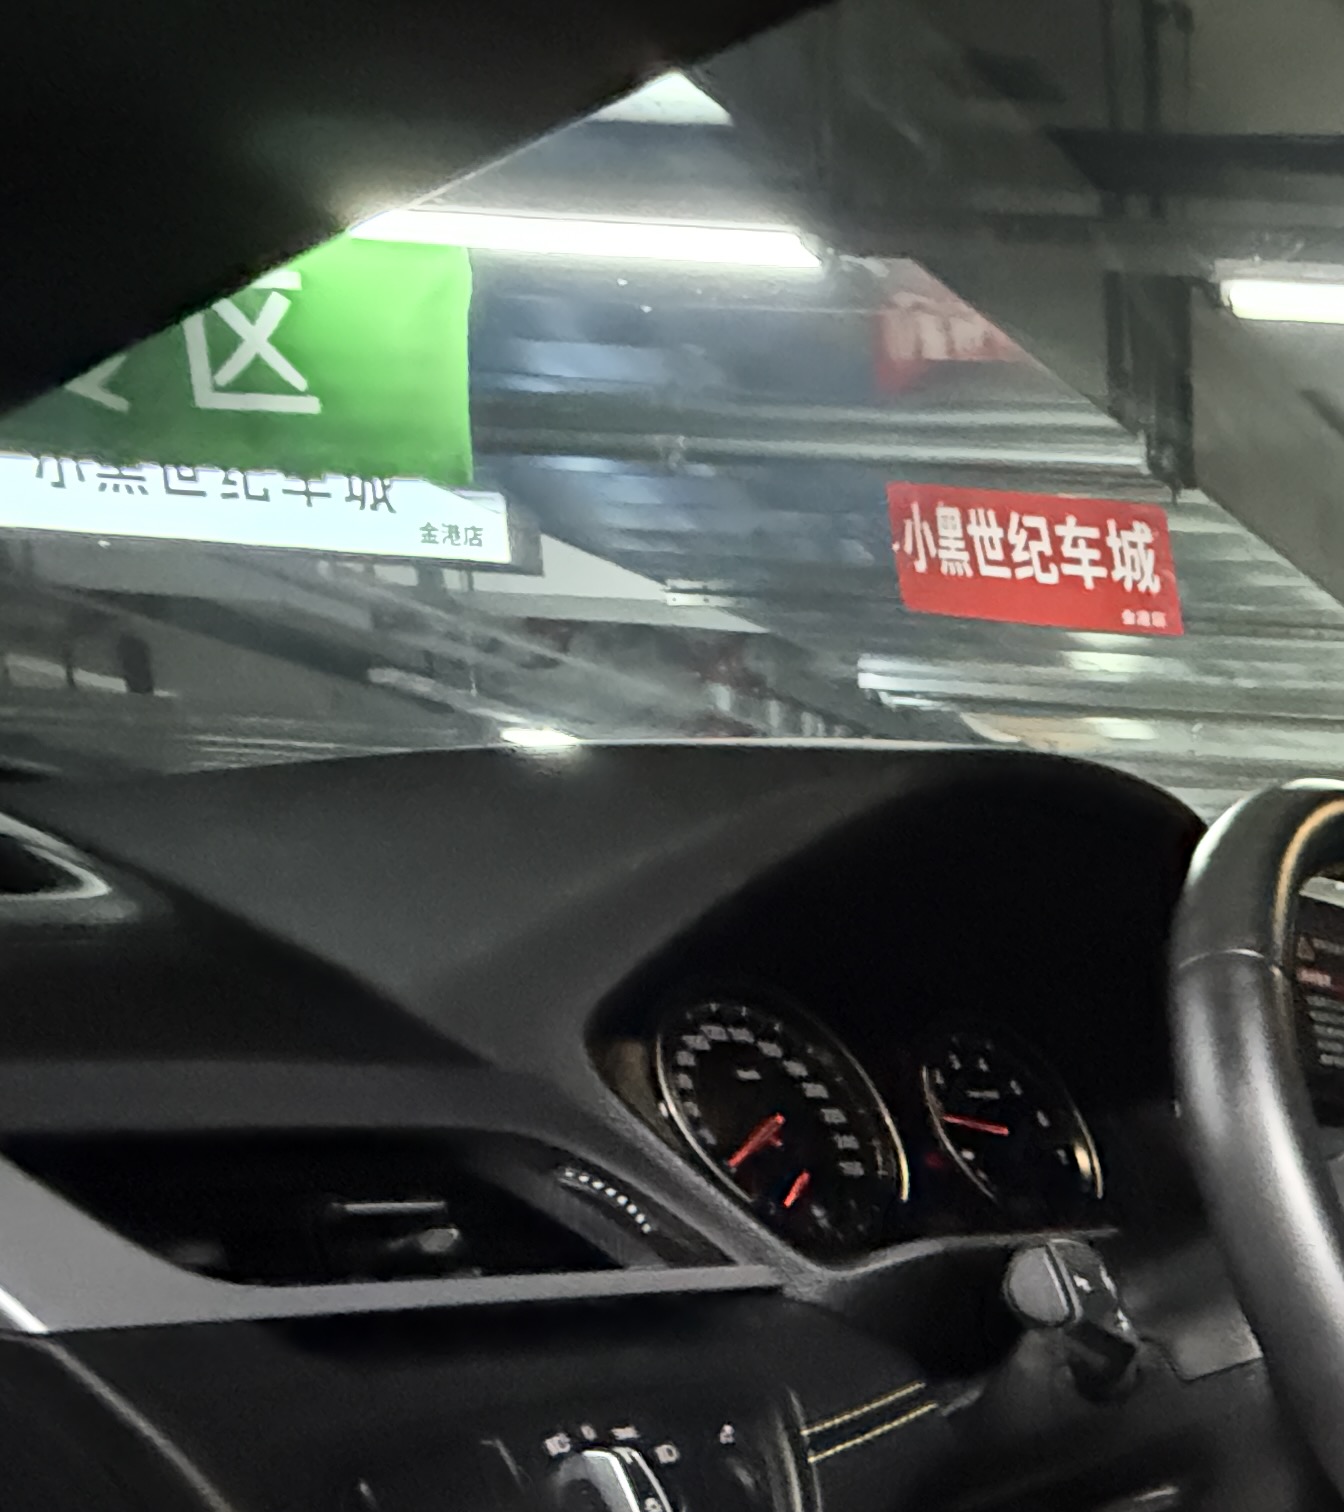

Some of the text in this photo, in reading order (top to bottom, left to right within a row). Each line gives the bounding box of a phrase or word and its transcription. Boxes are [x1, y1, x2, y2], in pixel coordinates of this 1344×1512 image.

[419, 521, 484, 547] 金港店
[902, 501, 1161, 595] 小黑世纪车城
